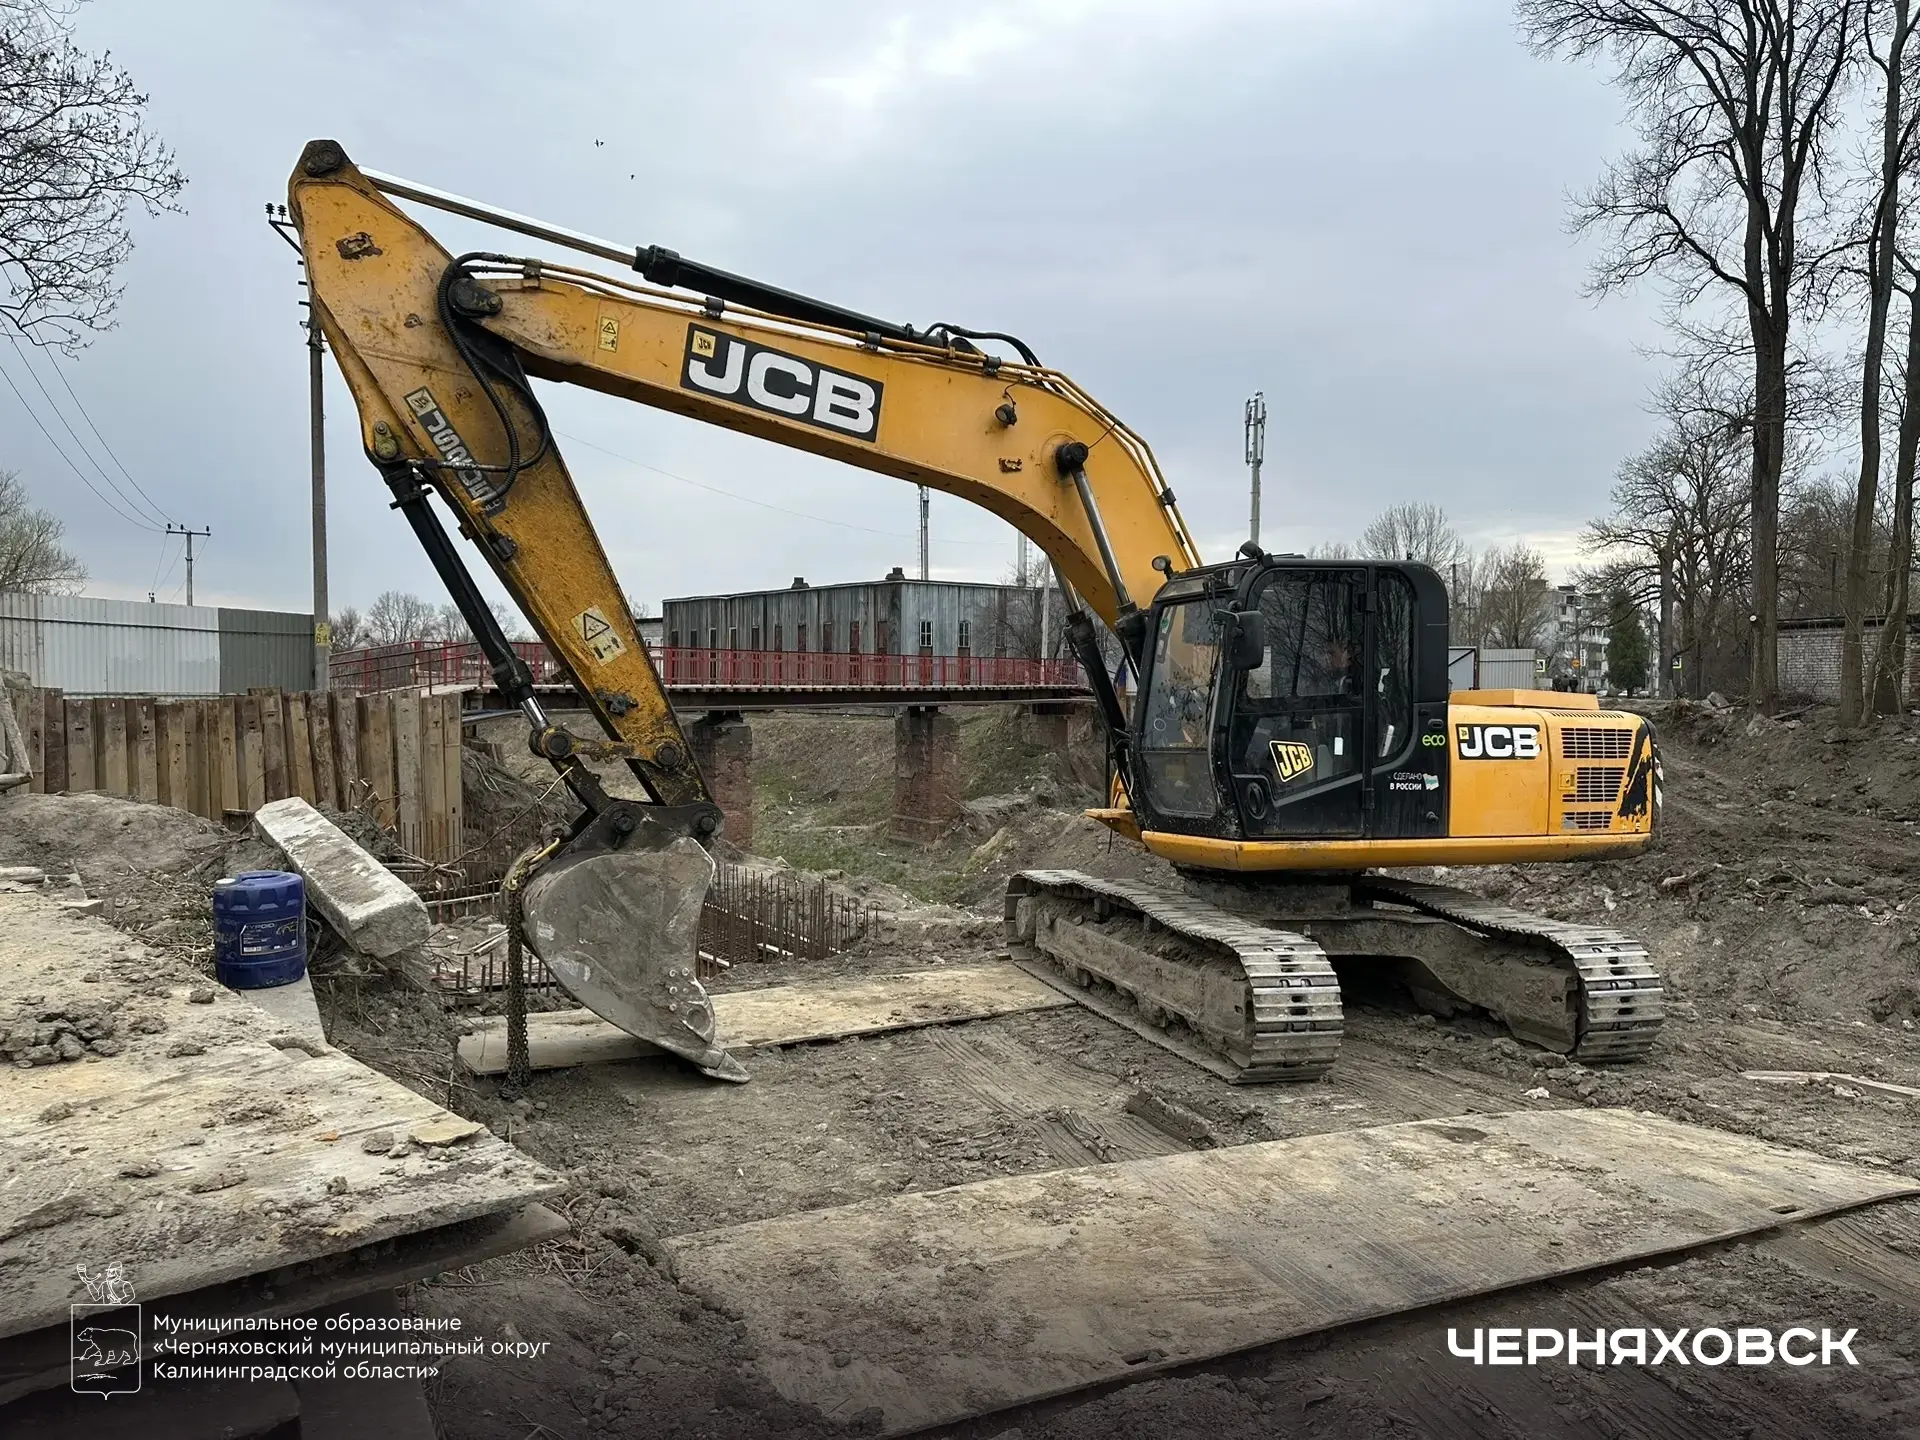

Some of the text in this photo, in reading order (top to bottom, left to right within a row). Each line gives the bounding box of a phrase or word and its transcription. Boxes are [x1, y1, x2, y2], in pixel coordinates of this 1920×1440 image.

[688, 341, 876, 434] JCB
[1422, 734, 1446, 746] eco
[1460, 727, 1541, 757] JCB
[1277, 744, 1312, 778] JCB
[1389, 782, 1422, 790] В РОССИИ
[1393, 772, 1422, 780] СДЕЛАНО
